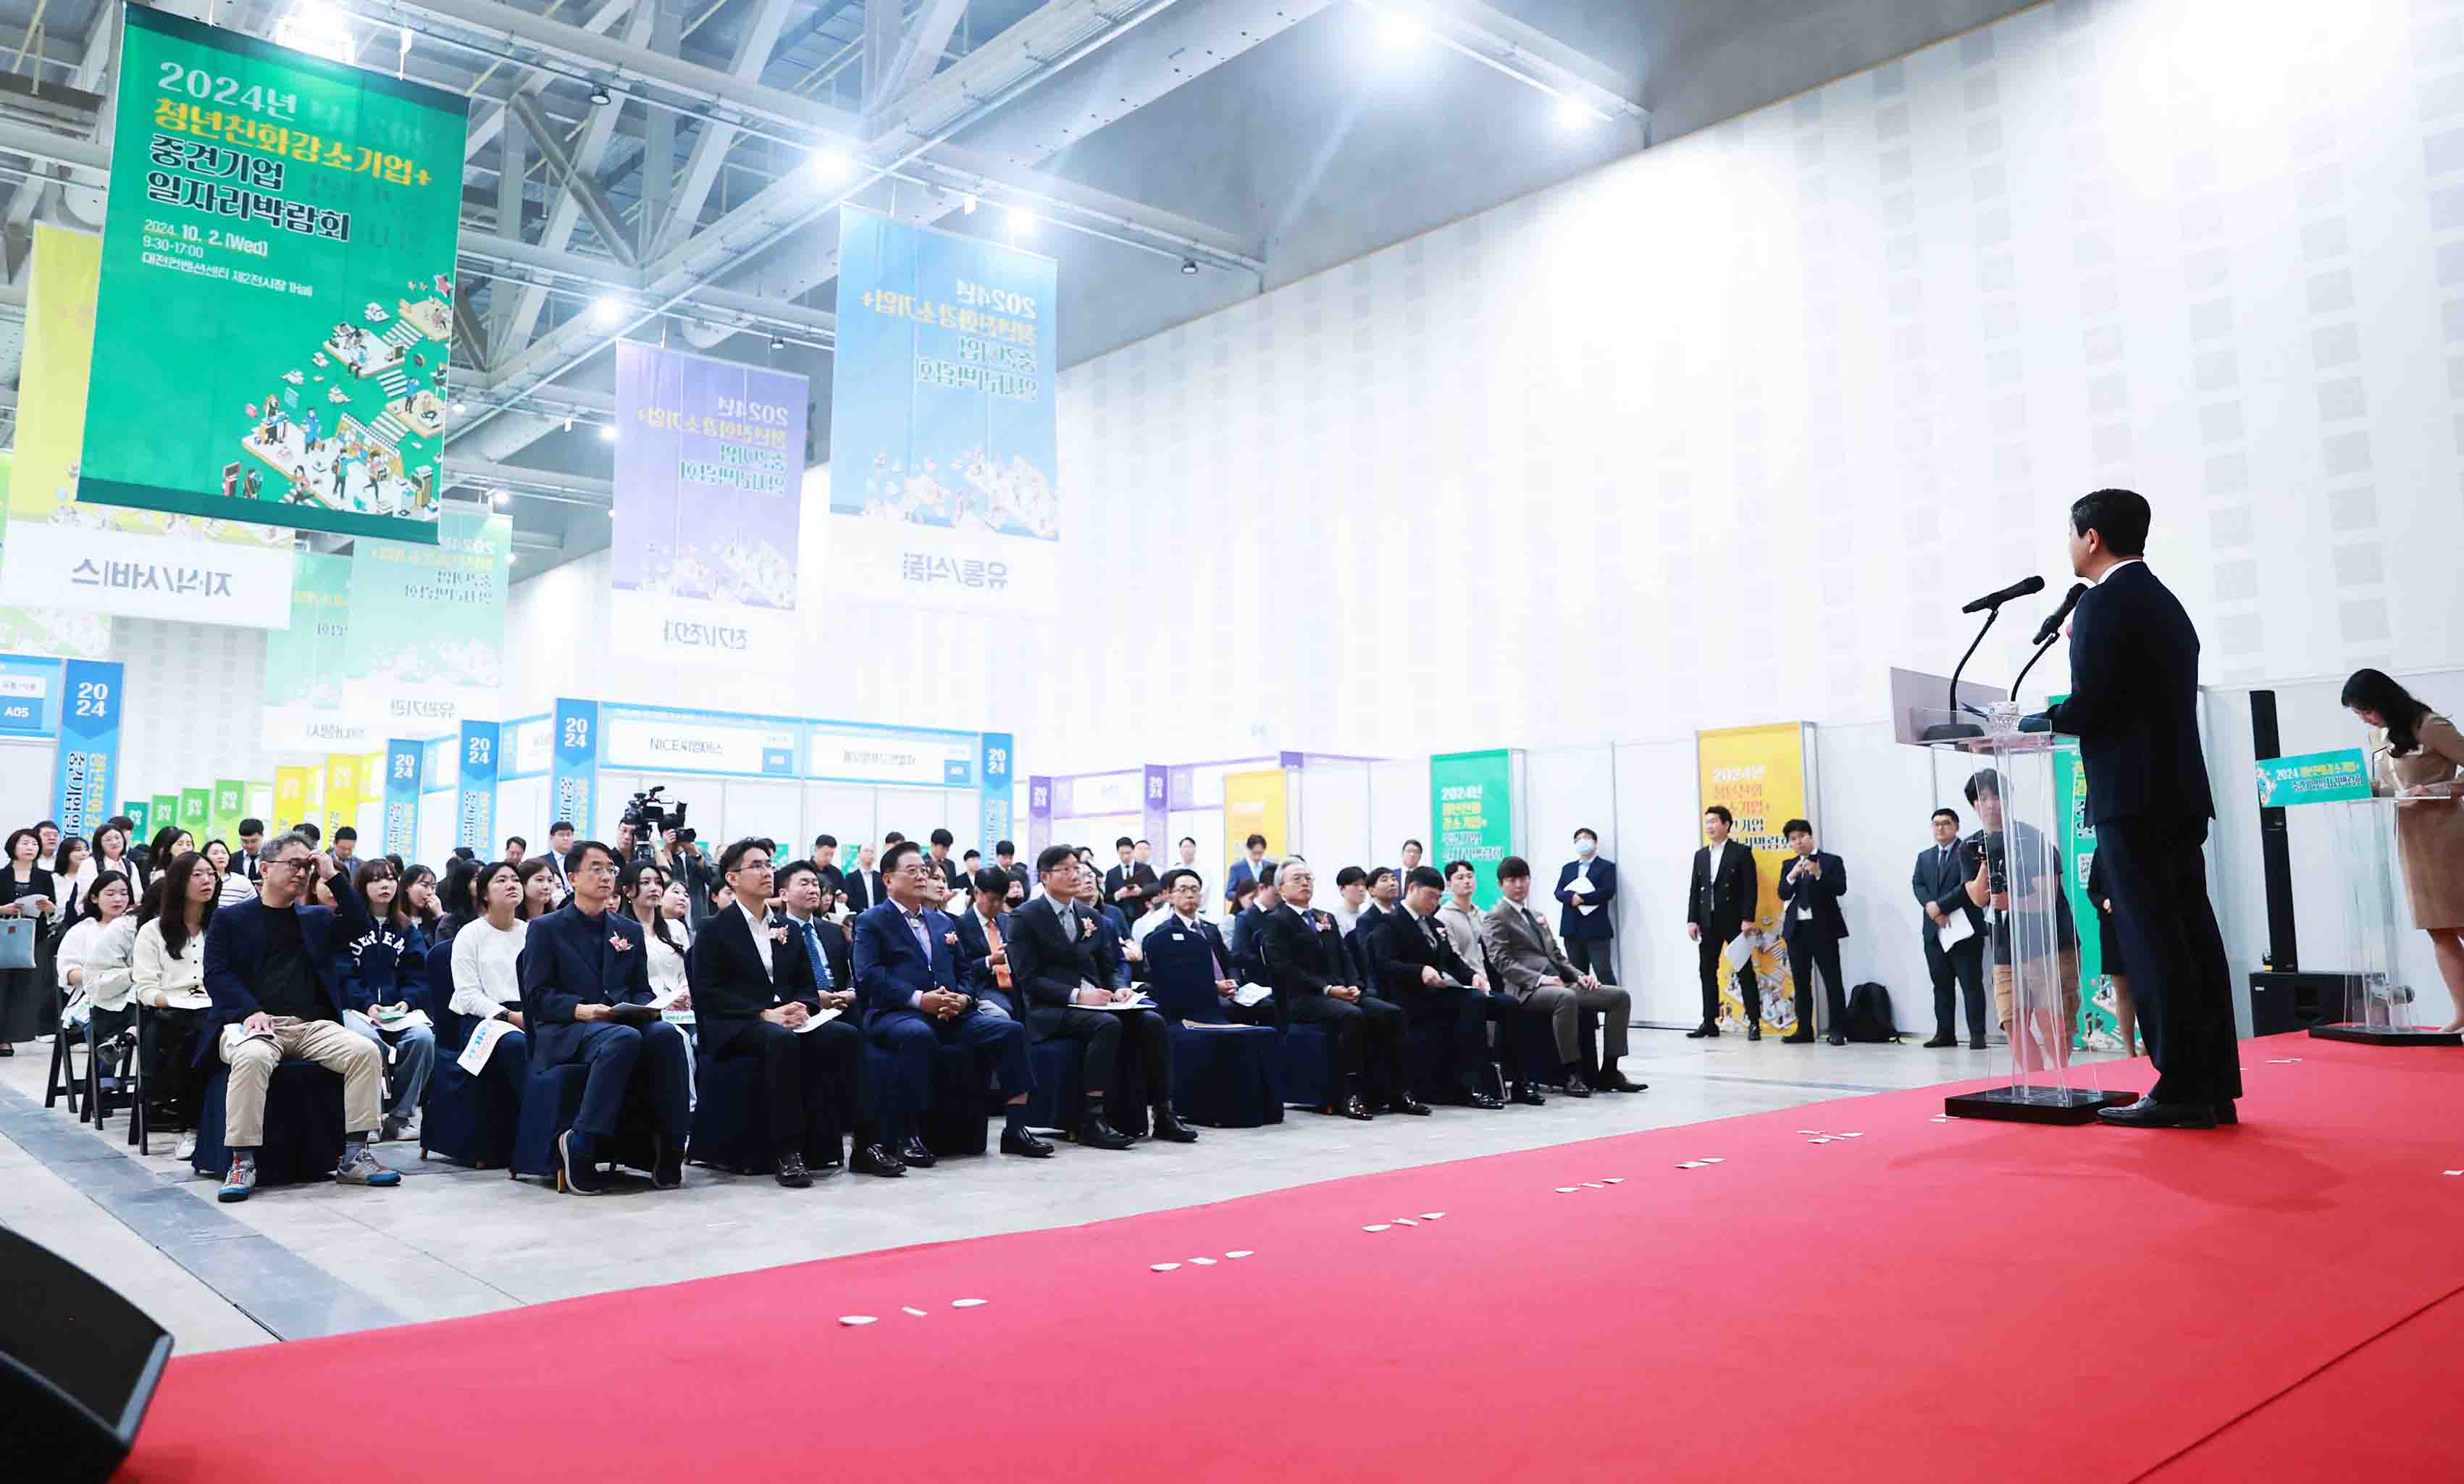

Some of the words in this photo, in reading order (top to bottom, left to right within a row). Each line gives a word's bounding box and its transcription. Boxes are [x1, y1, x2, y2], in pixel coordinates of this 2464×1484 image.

[157, 62, 296, 122] 2024년
[154, 98, 432, 185] 청년친화강소기업+
[149, 133, 285, 191] 중견기업
[146, 170, 351, 243] 일자리박람회
[182, 224, 202, 242] 10.
[77, 682, 109, 700] 20
[5, 706, 30, 718] A05
[75, 700, 107, 718] 24
[564, 717, 587, 732] 20
[469, 737, 490, 751] 20
[563, 733, 587, 748] 24
[395, 753, 415, 766] 20
[468, 750, 490, 764] 24
[987, 747, 1007, 761] 20
